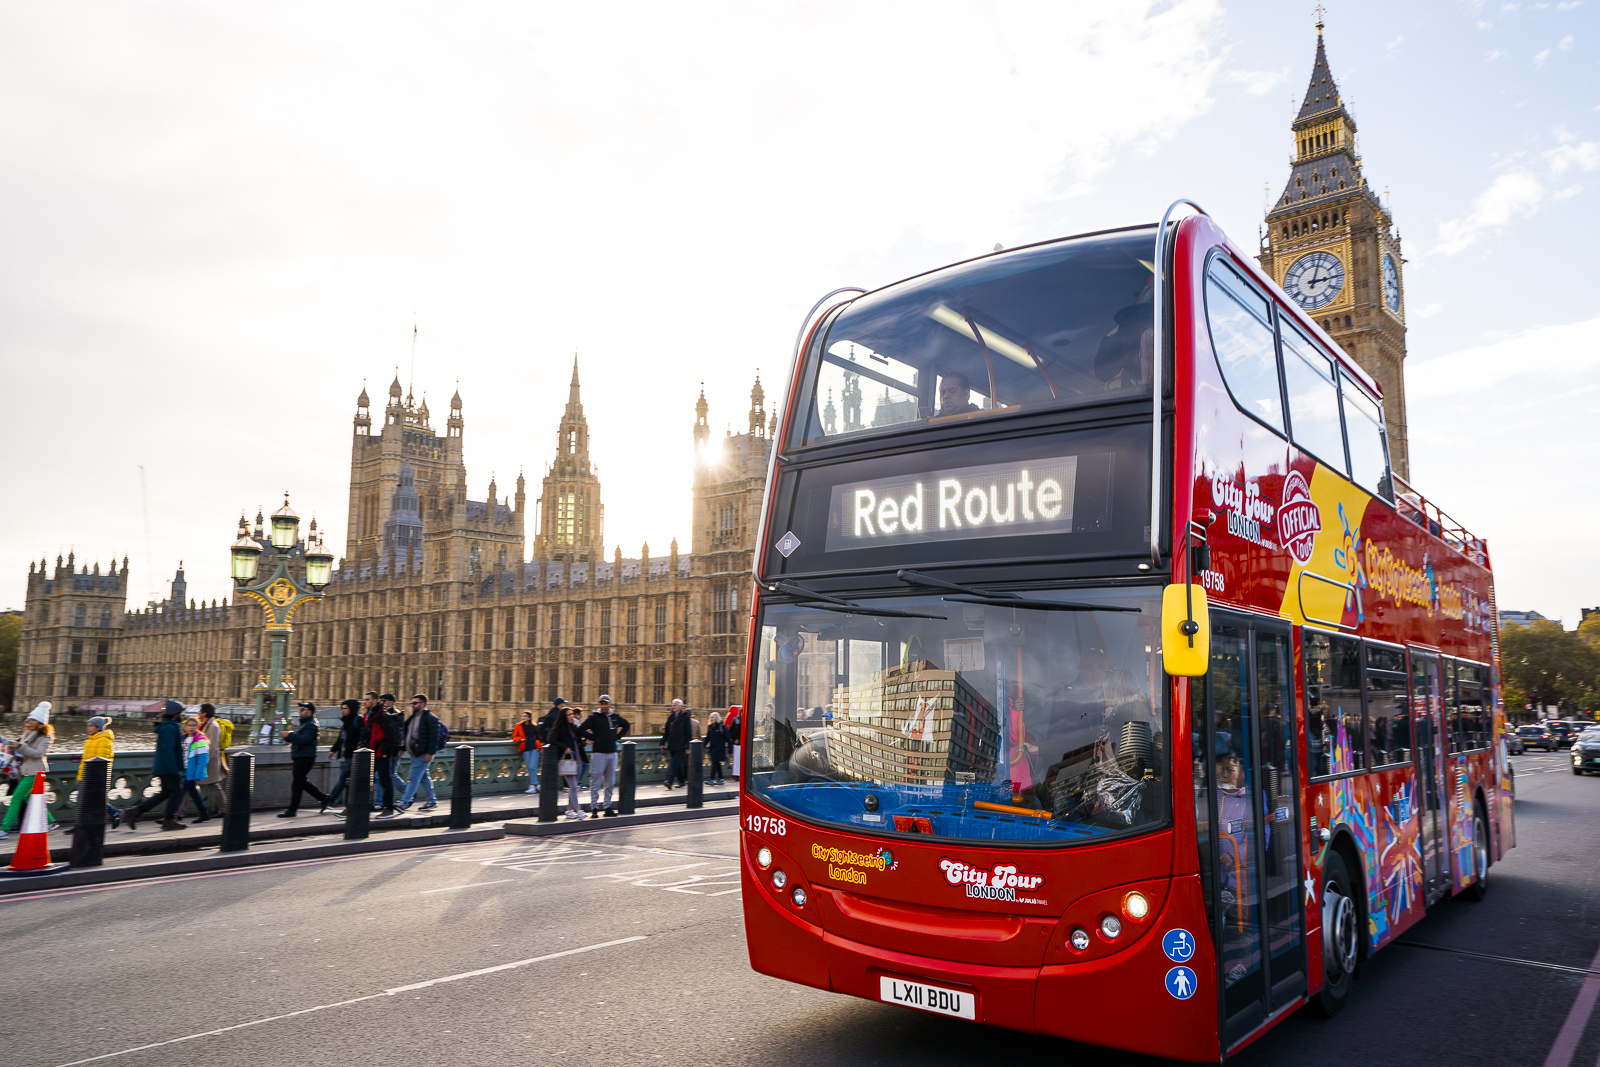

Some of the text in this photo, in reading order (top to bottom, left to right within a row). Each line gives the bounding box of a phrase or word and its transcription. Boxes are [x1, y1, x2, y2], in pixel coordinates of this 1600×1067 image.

[854, 469, 1062, 536] Red Route
[1205, 460, 1274, 523] City Tour
[1227, 509, 1261, 545] LONDON
[1282, 505, 1320, 539] OFFICIAL
[1200, 569, 1225, 592] 19758
[746, 814, 787, 836] 19758
[828, 864, 867, 885] London
[940, 860, 1042, 889] City Tour
[966, 884, 1015, 901] LONDON
[893, 981, 960, 1012] LX11 BDU
